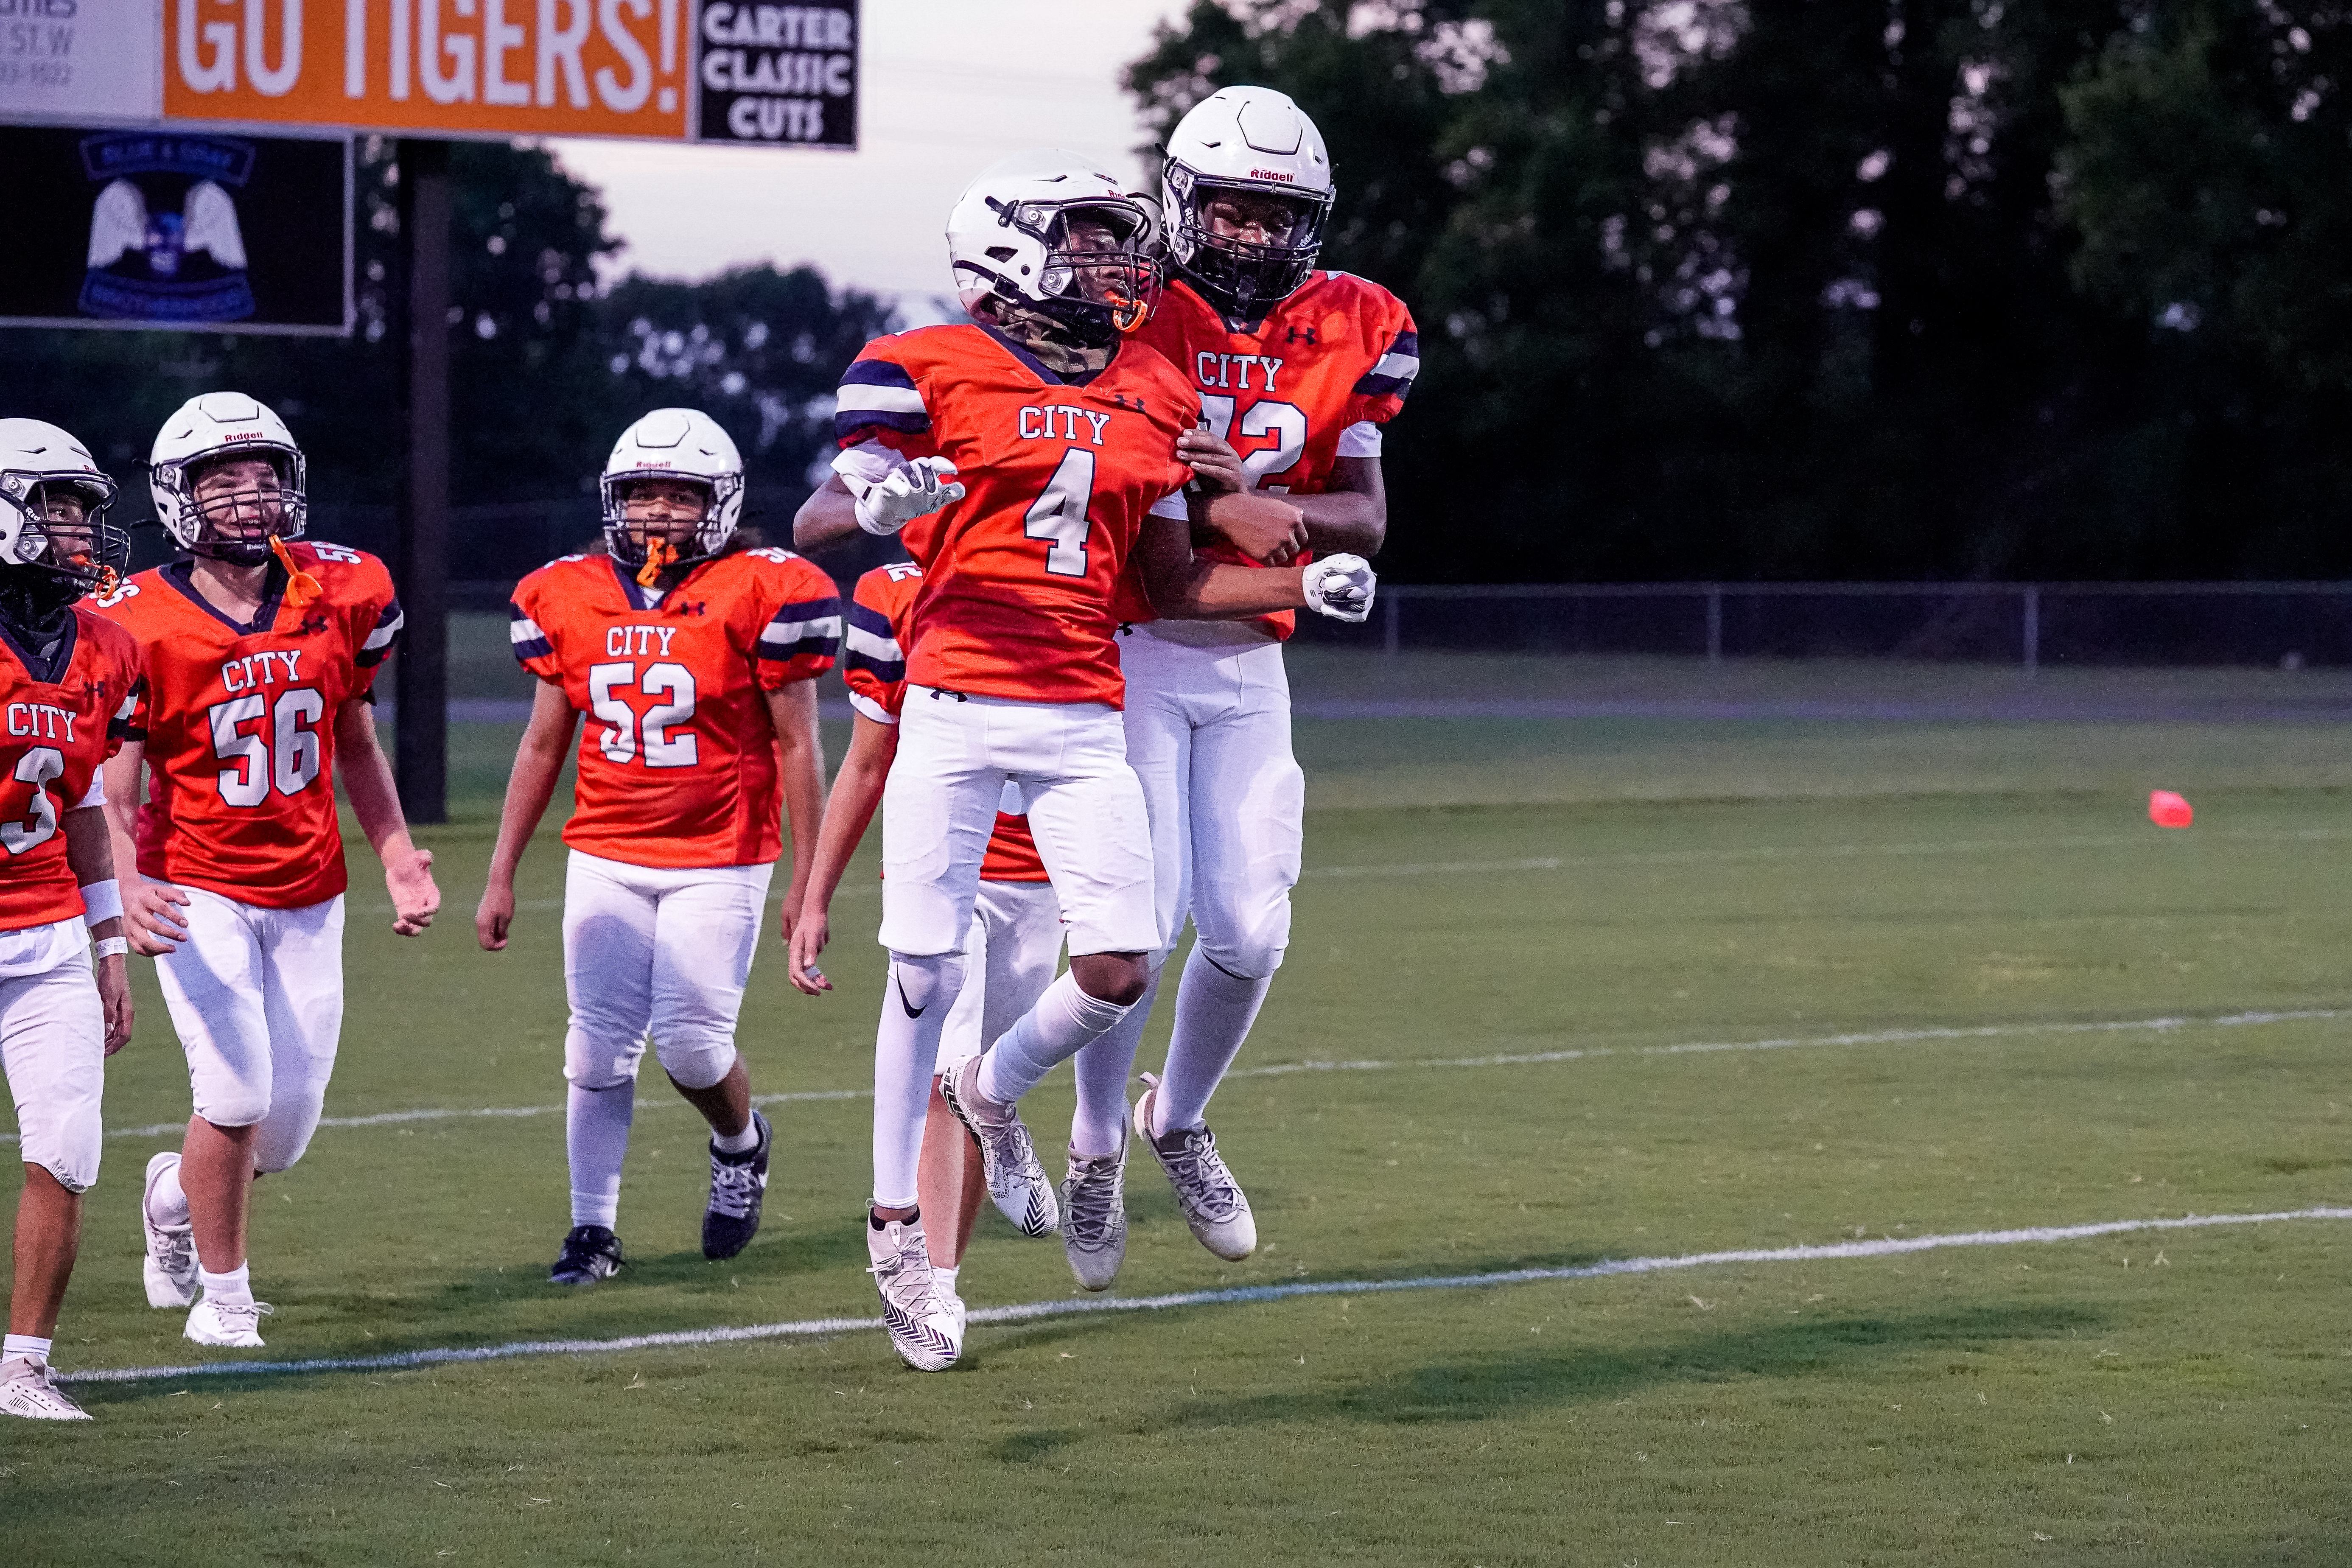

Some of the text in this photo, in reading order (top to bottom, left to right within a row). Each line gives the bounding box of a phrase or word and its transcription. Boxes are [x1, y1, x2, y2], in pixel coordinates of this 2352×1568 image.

[702, 2, 852, 49] CARTER
[176, 0, 680, 114] GO TIGERS!
[701, 48, 851, 96] CLASSIC
[727, 96, 824, 140] CUTS
[1250, 169, 1293, 182] Riddell
[1196, 351, 1282, 392] CITY
[225, 432, 263, 442] Riddell
[1019, 405, 1110, 445] CITY
[1025, 448, 1094, 577] 4
[606, 624, 677, 657] CITY
[221, 650, 301, 692] CITY
[8, 703, 77, 743] CITY
[588, 662, 697, 767] 52
[209, 688, 324, 807] 56
[0, 747, 64, 854] 3
